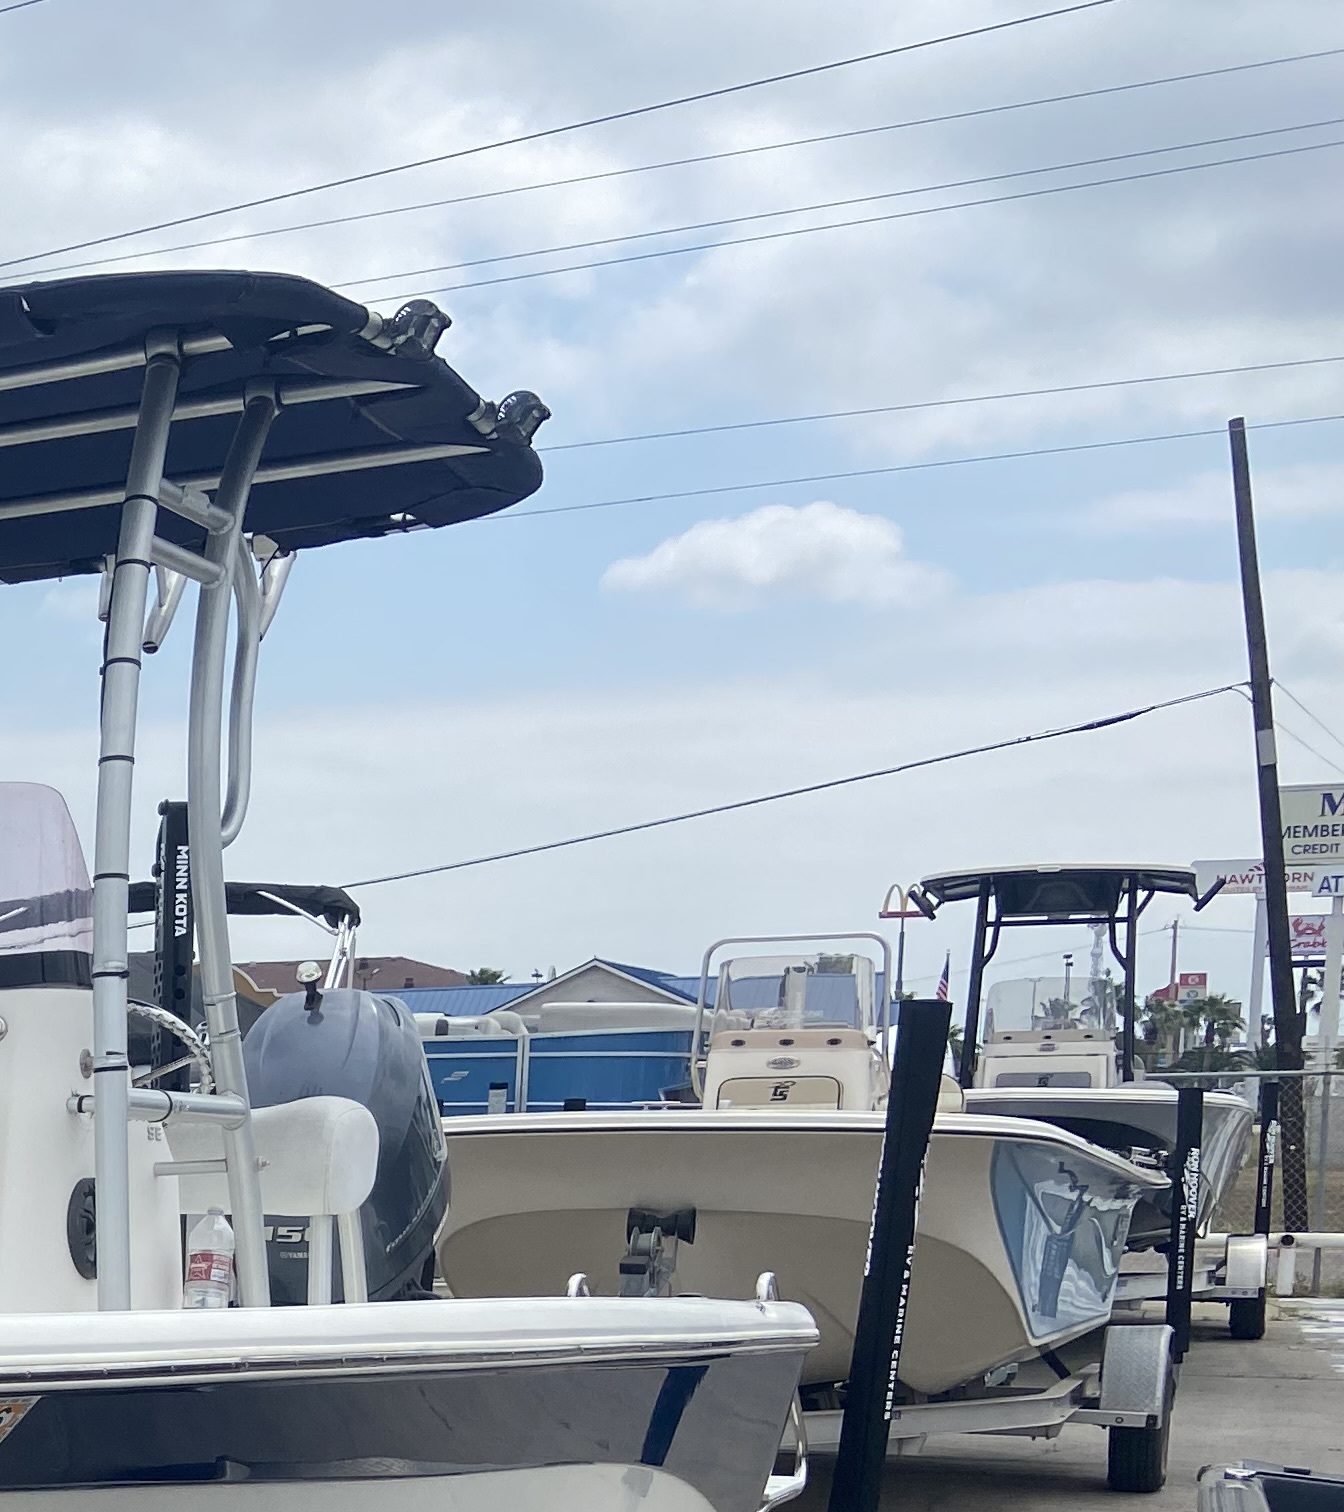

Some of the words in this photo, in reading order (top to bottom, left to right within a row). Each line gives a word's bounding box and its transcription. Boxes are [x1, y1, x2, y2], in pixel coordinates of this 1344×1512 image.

[175, 845, 189, 890] MINN
[1291, 843, 1340, 855] CREDIT
[1216, 871, 1315, 885] HAWTORN
[174, 892, 188, 937] KOTA
[893, 1284, 909, 1345] MARINE
[883, 1349, 899, 1420] CENTERS
